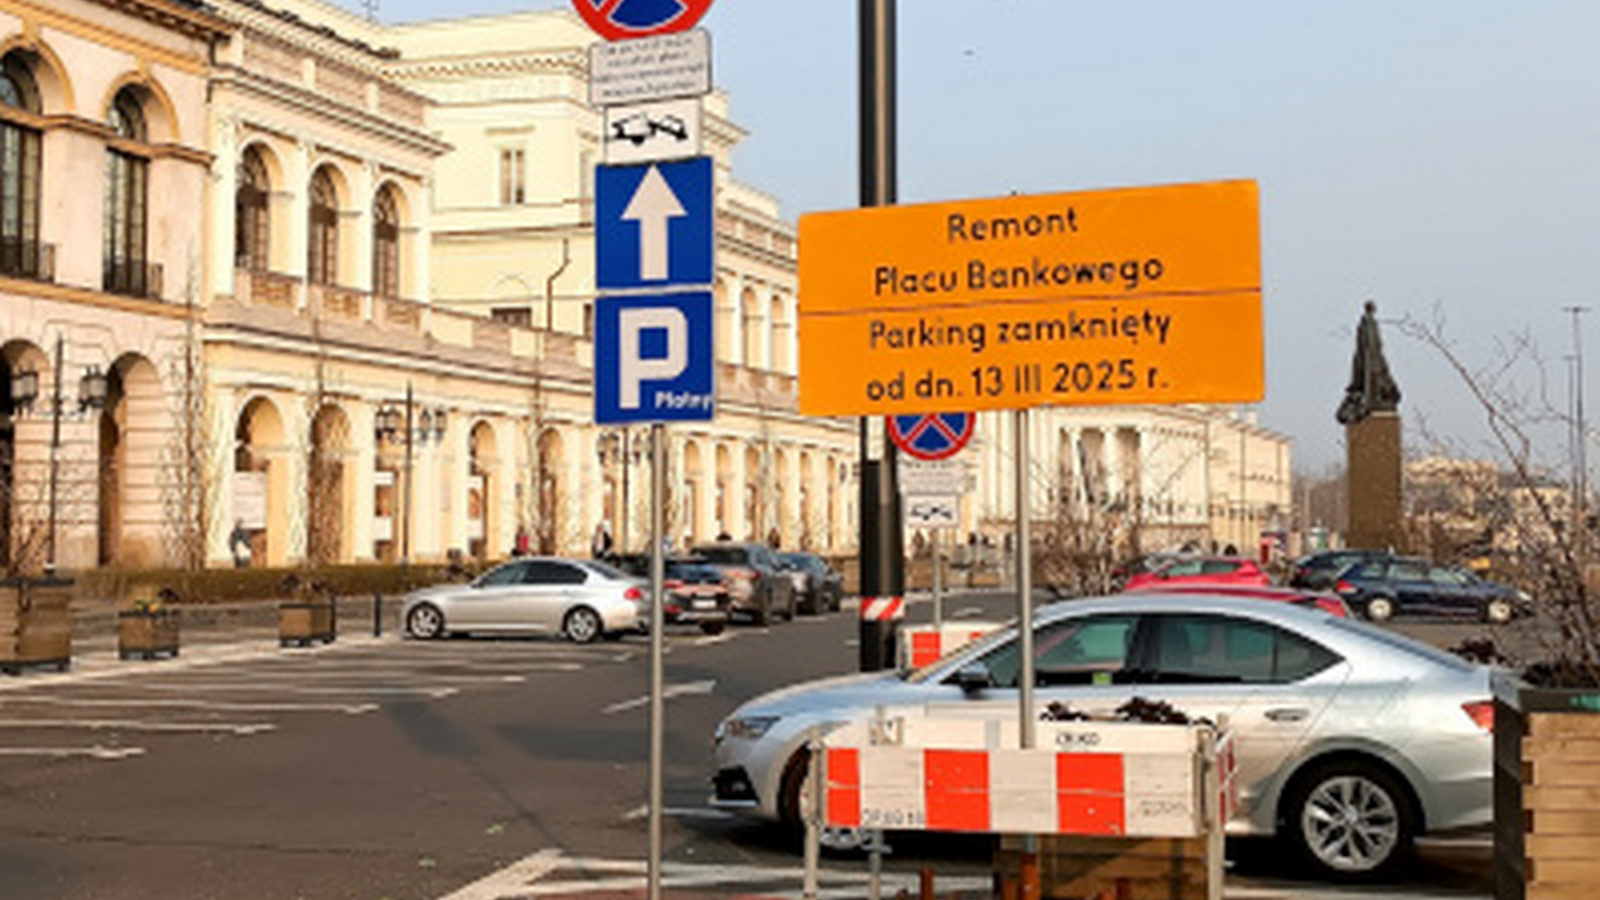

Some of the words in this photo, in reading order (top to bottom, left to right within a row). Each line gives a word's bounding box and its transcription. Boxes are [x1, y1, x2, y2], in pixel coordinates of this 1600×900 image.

[948, 208, 1078, 241] Remont
[875, 266, 957, 295] Placu
[967, 257, 1164, 290] Bankowego
[869, 318, 986, 352] Parking
[998, 308, 1171, 344] zamknięty
[619, 306, 688, 409] P
[866, 372, 905, 401] od
[915, 370, 963, 398] dn.
[971, 367, 1003, 397] 13
[1014, 365, 1041, 393] III
[1053, 359, 1136, 393] 2025
[1147, 367, 1169, 389] r.
